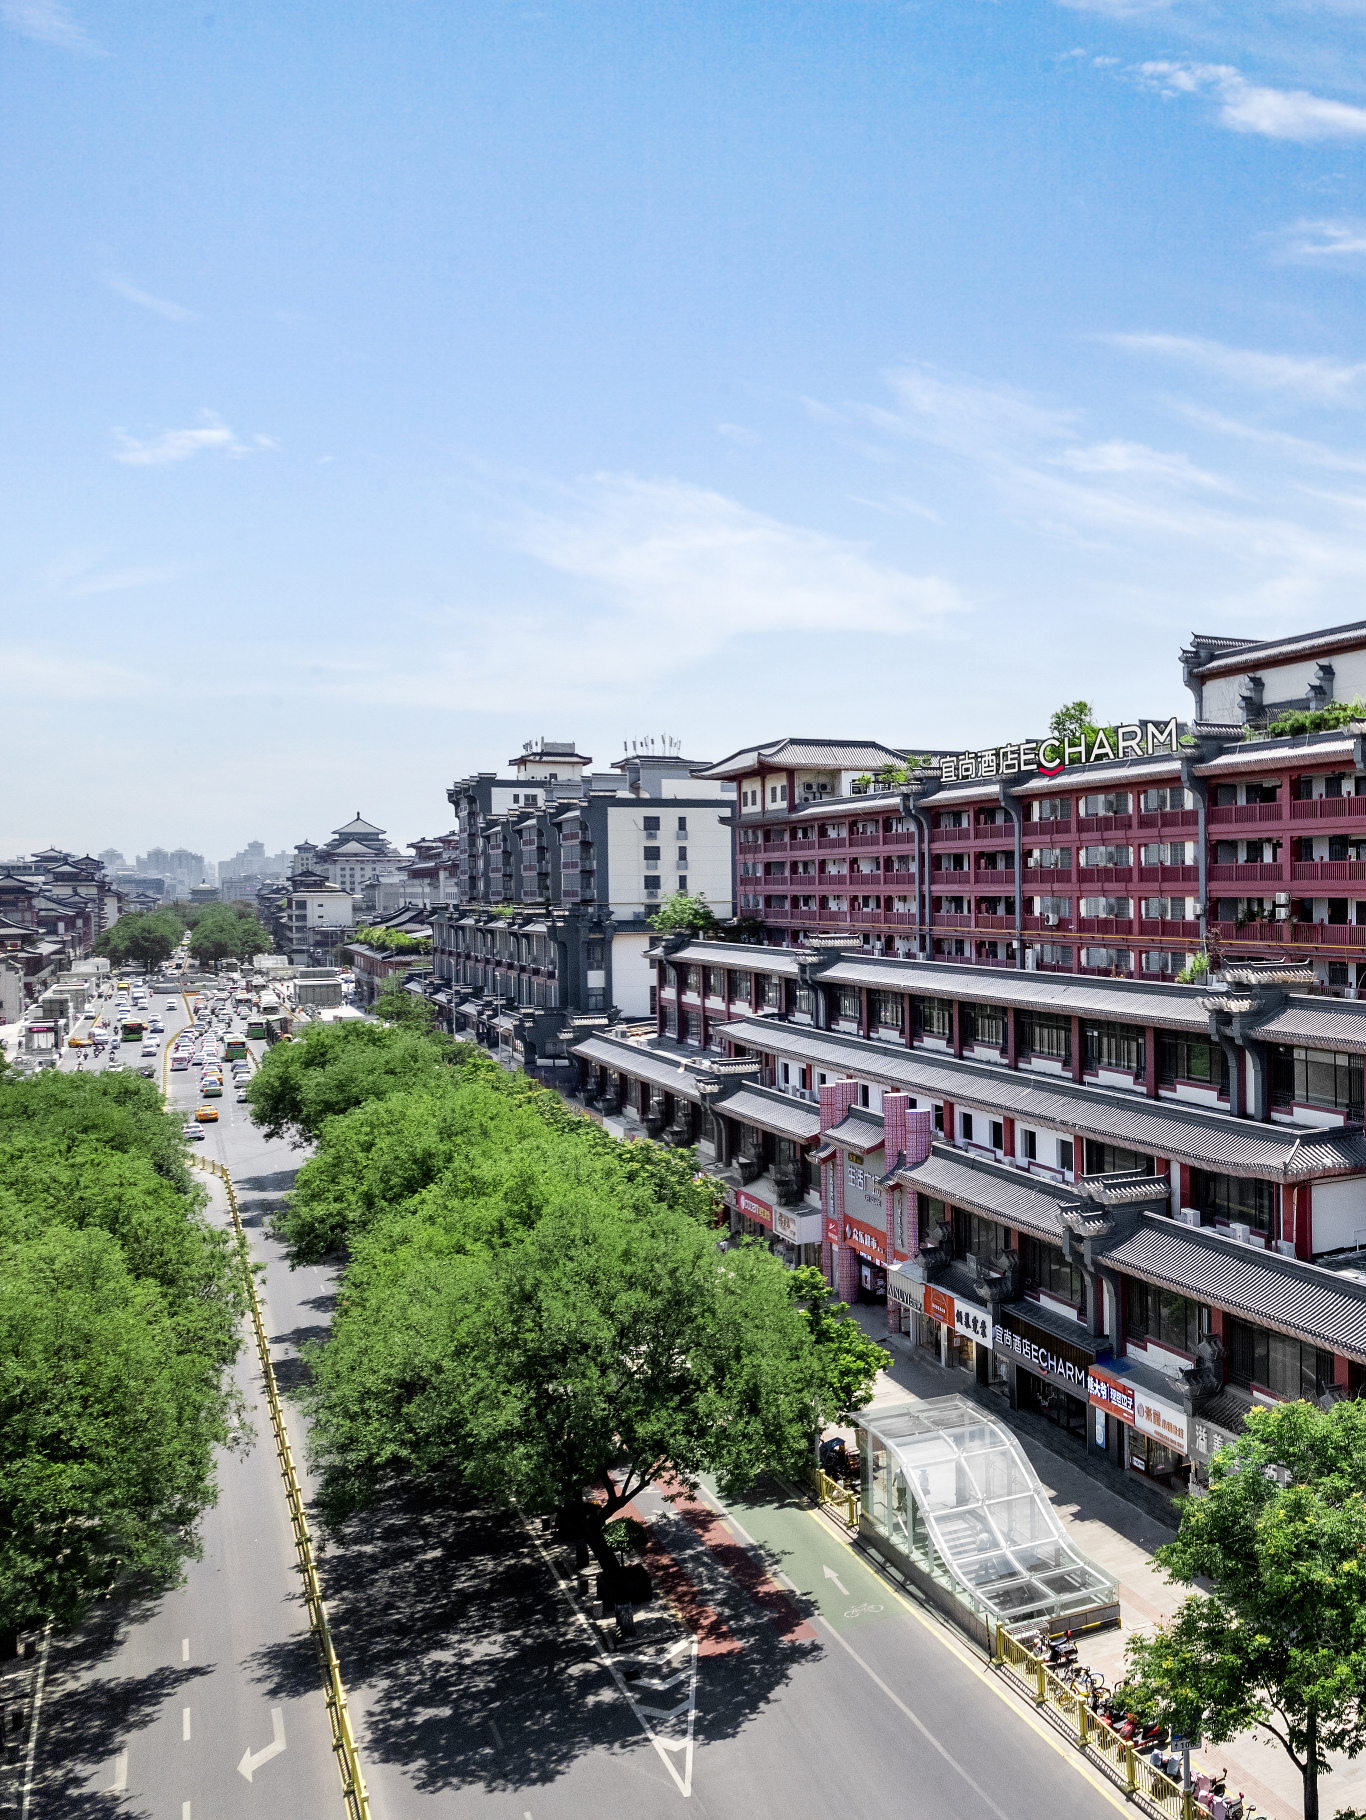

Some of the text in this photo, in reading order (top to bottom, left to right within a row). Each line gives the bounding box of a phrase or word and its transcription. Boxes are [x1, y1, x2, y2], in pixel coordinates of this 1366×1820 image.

[940, 717, 1178, 783] 宜尚酒店 ECHARM
[995, 1324, 1031, 1360] 宜尚酒店
[1031, 1343, 1085, 1388] ECHARM
